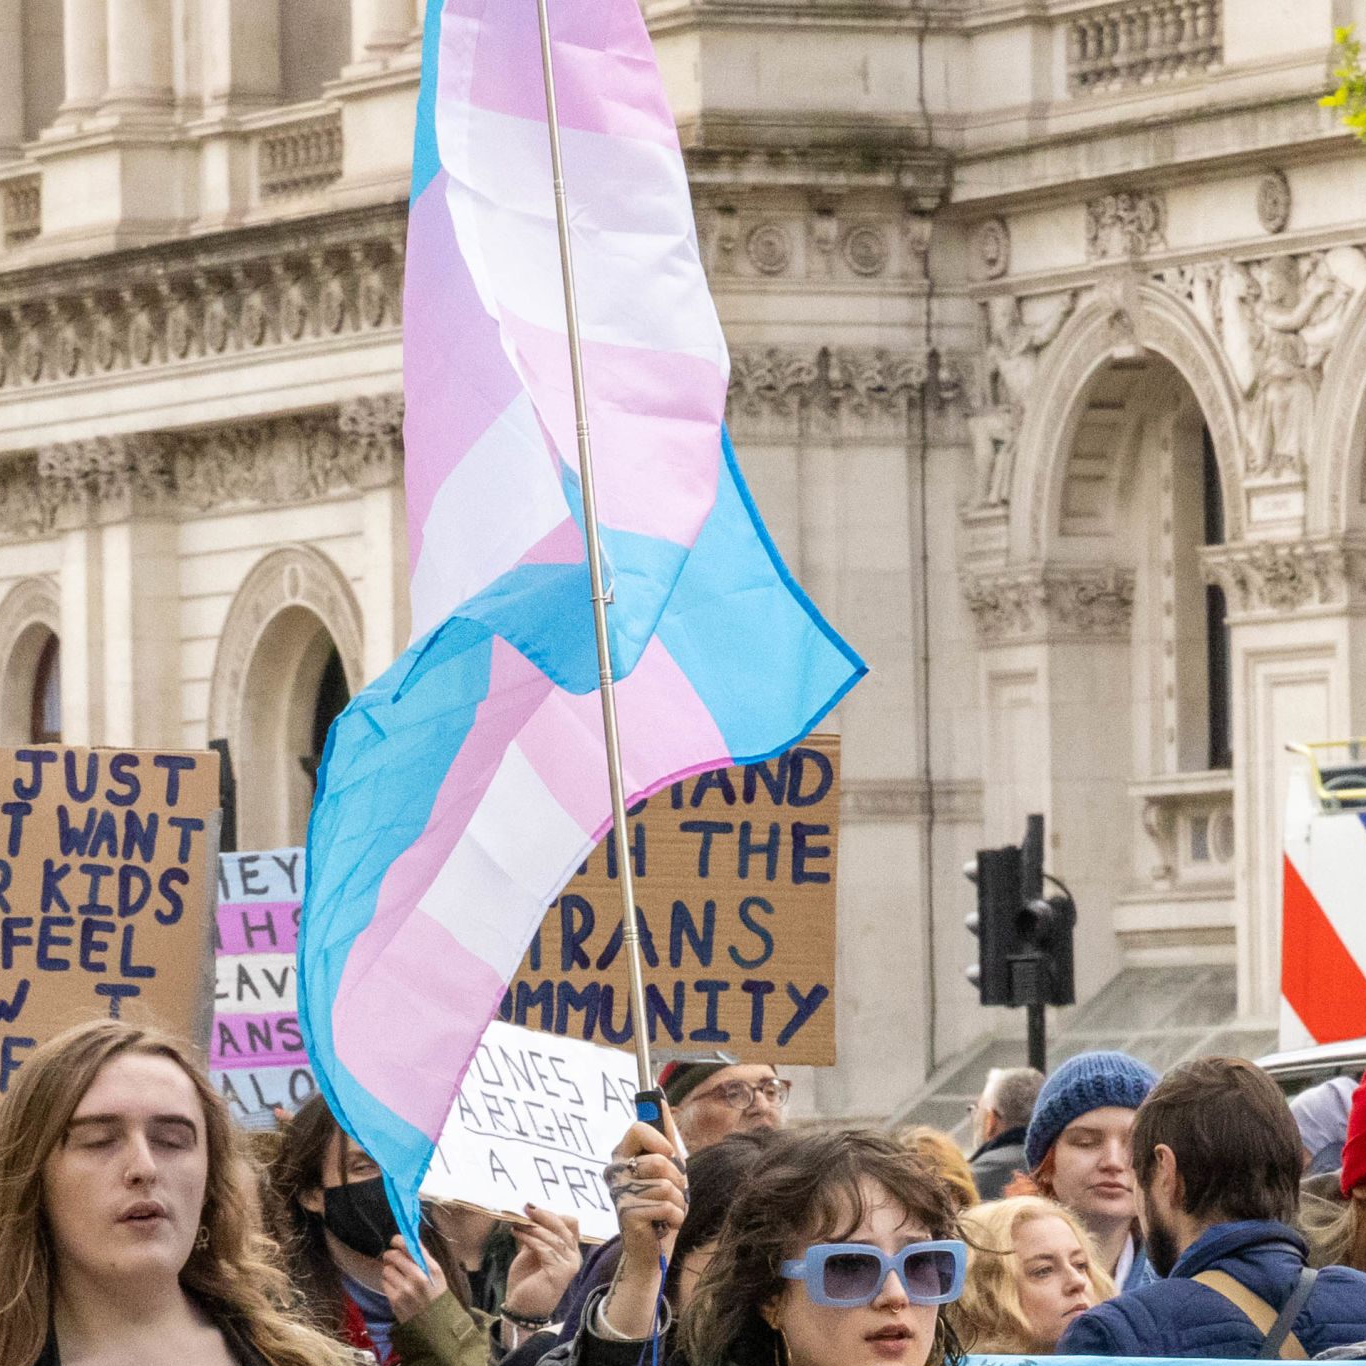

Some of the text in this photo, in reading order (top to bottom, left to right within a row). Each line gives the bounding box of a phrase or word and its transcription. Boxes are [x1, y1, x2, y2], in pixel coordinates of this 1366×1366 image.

[13, 749, 196, 807] JUST
[628, 748, 833, 816] AND
[57, 804, 204, 864] WANT
[679, 821, 830, 884] THE
[41, 858, 190, 925] KIDS
[1, 916, 156, 979] FEEL
[481, 1091, 595, 1155] RIGHT
[534, 1157, 611, 1212] PRI
